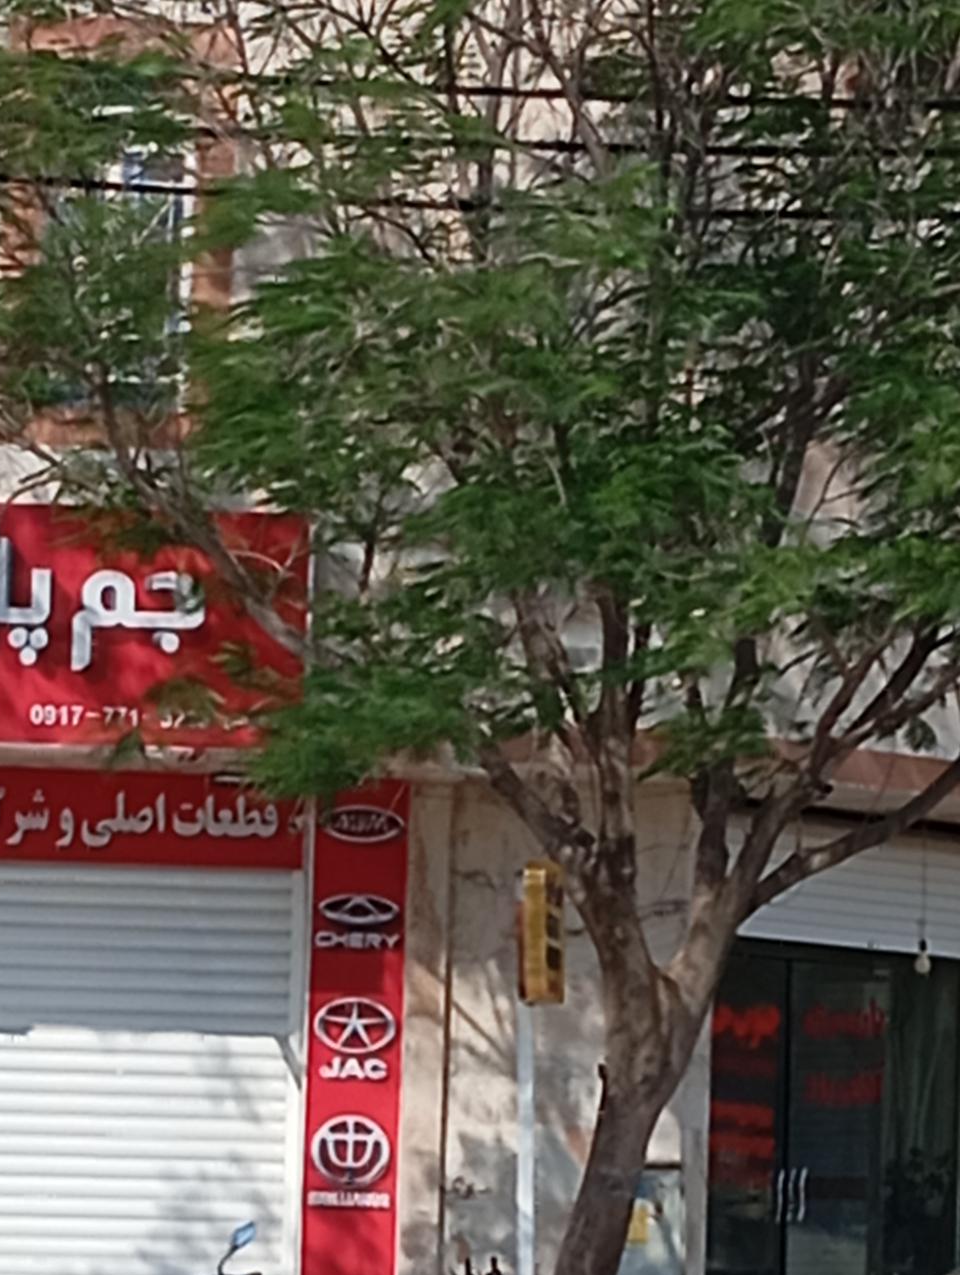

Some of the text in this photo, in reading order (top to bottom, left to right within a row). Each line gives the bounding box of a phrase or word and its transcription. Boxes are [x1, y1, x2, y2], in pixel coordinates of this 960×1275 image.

[55, 806, 75, 847] و
[81, 790, 166, 847] اصلی
[172, 794, 279, 838] قطعات
[314, 930, 400, 949] CHERY
[318, 1056, 388, 1080] JAC
